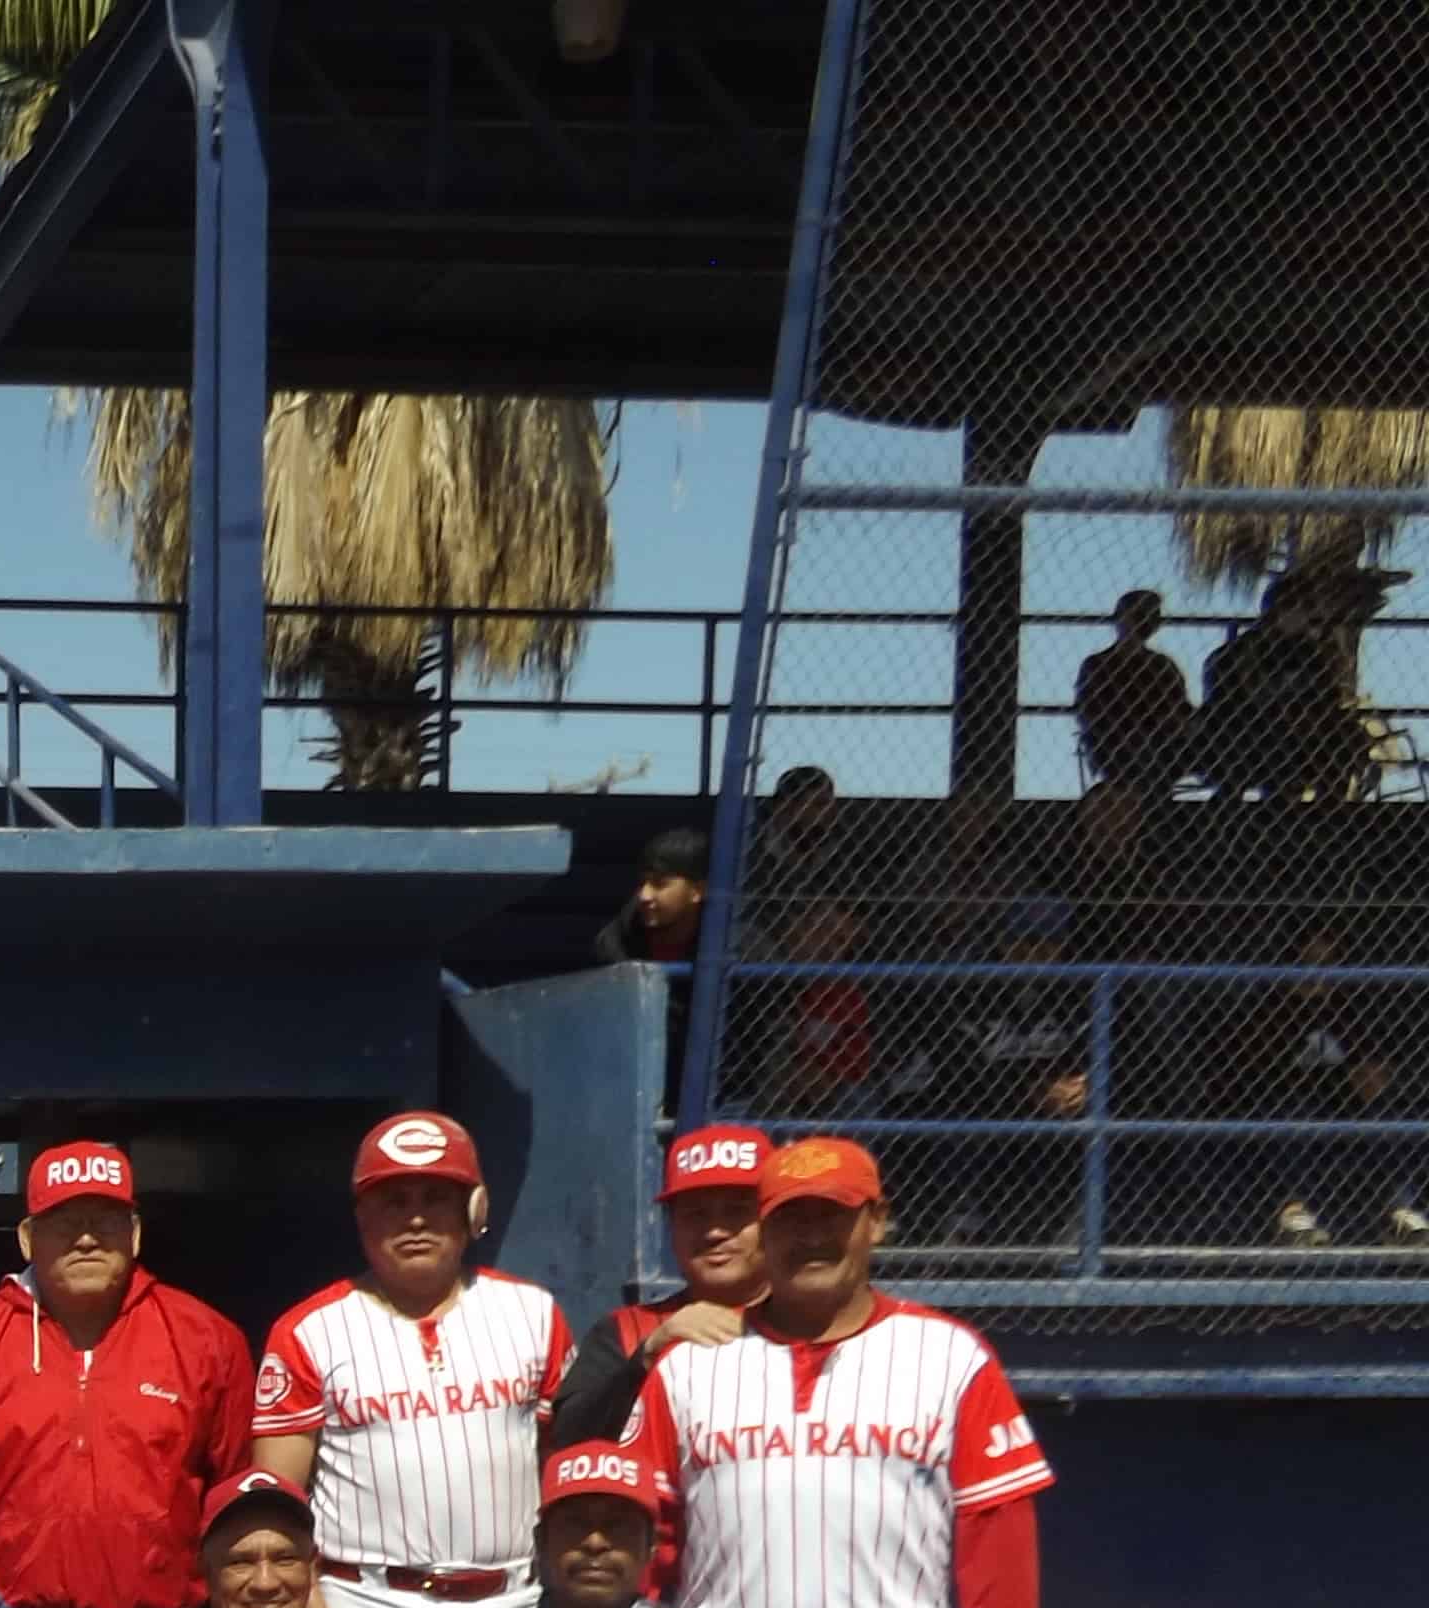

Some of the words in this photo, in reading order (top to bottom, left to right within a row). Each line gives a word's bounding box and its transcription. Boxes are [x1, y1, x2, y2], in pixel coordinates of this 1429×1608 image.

[46, 1156, 123, 1187] ROJOS
[676, 1139, 758, 1174] ROJOS
[557, 1453, 639, 1488] ROJOS
